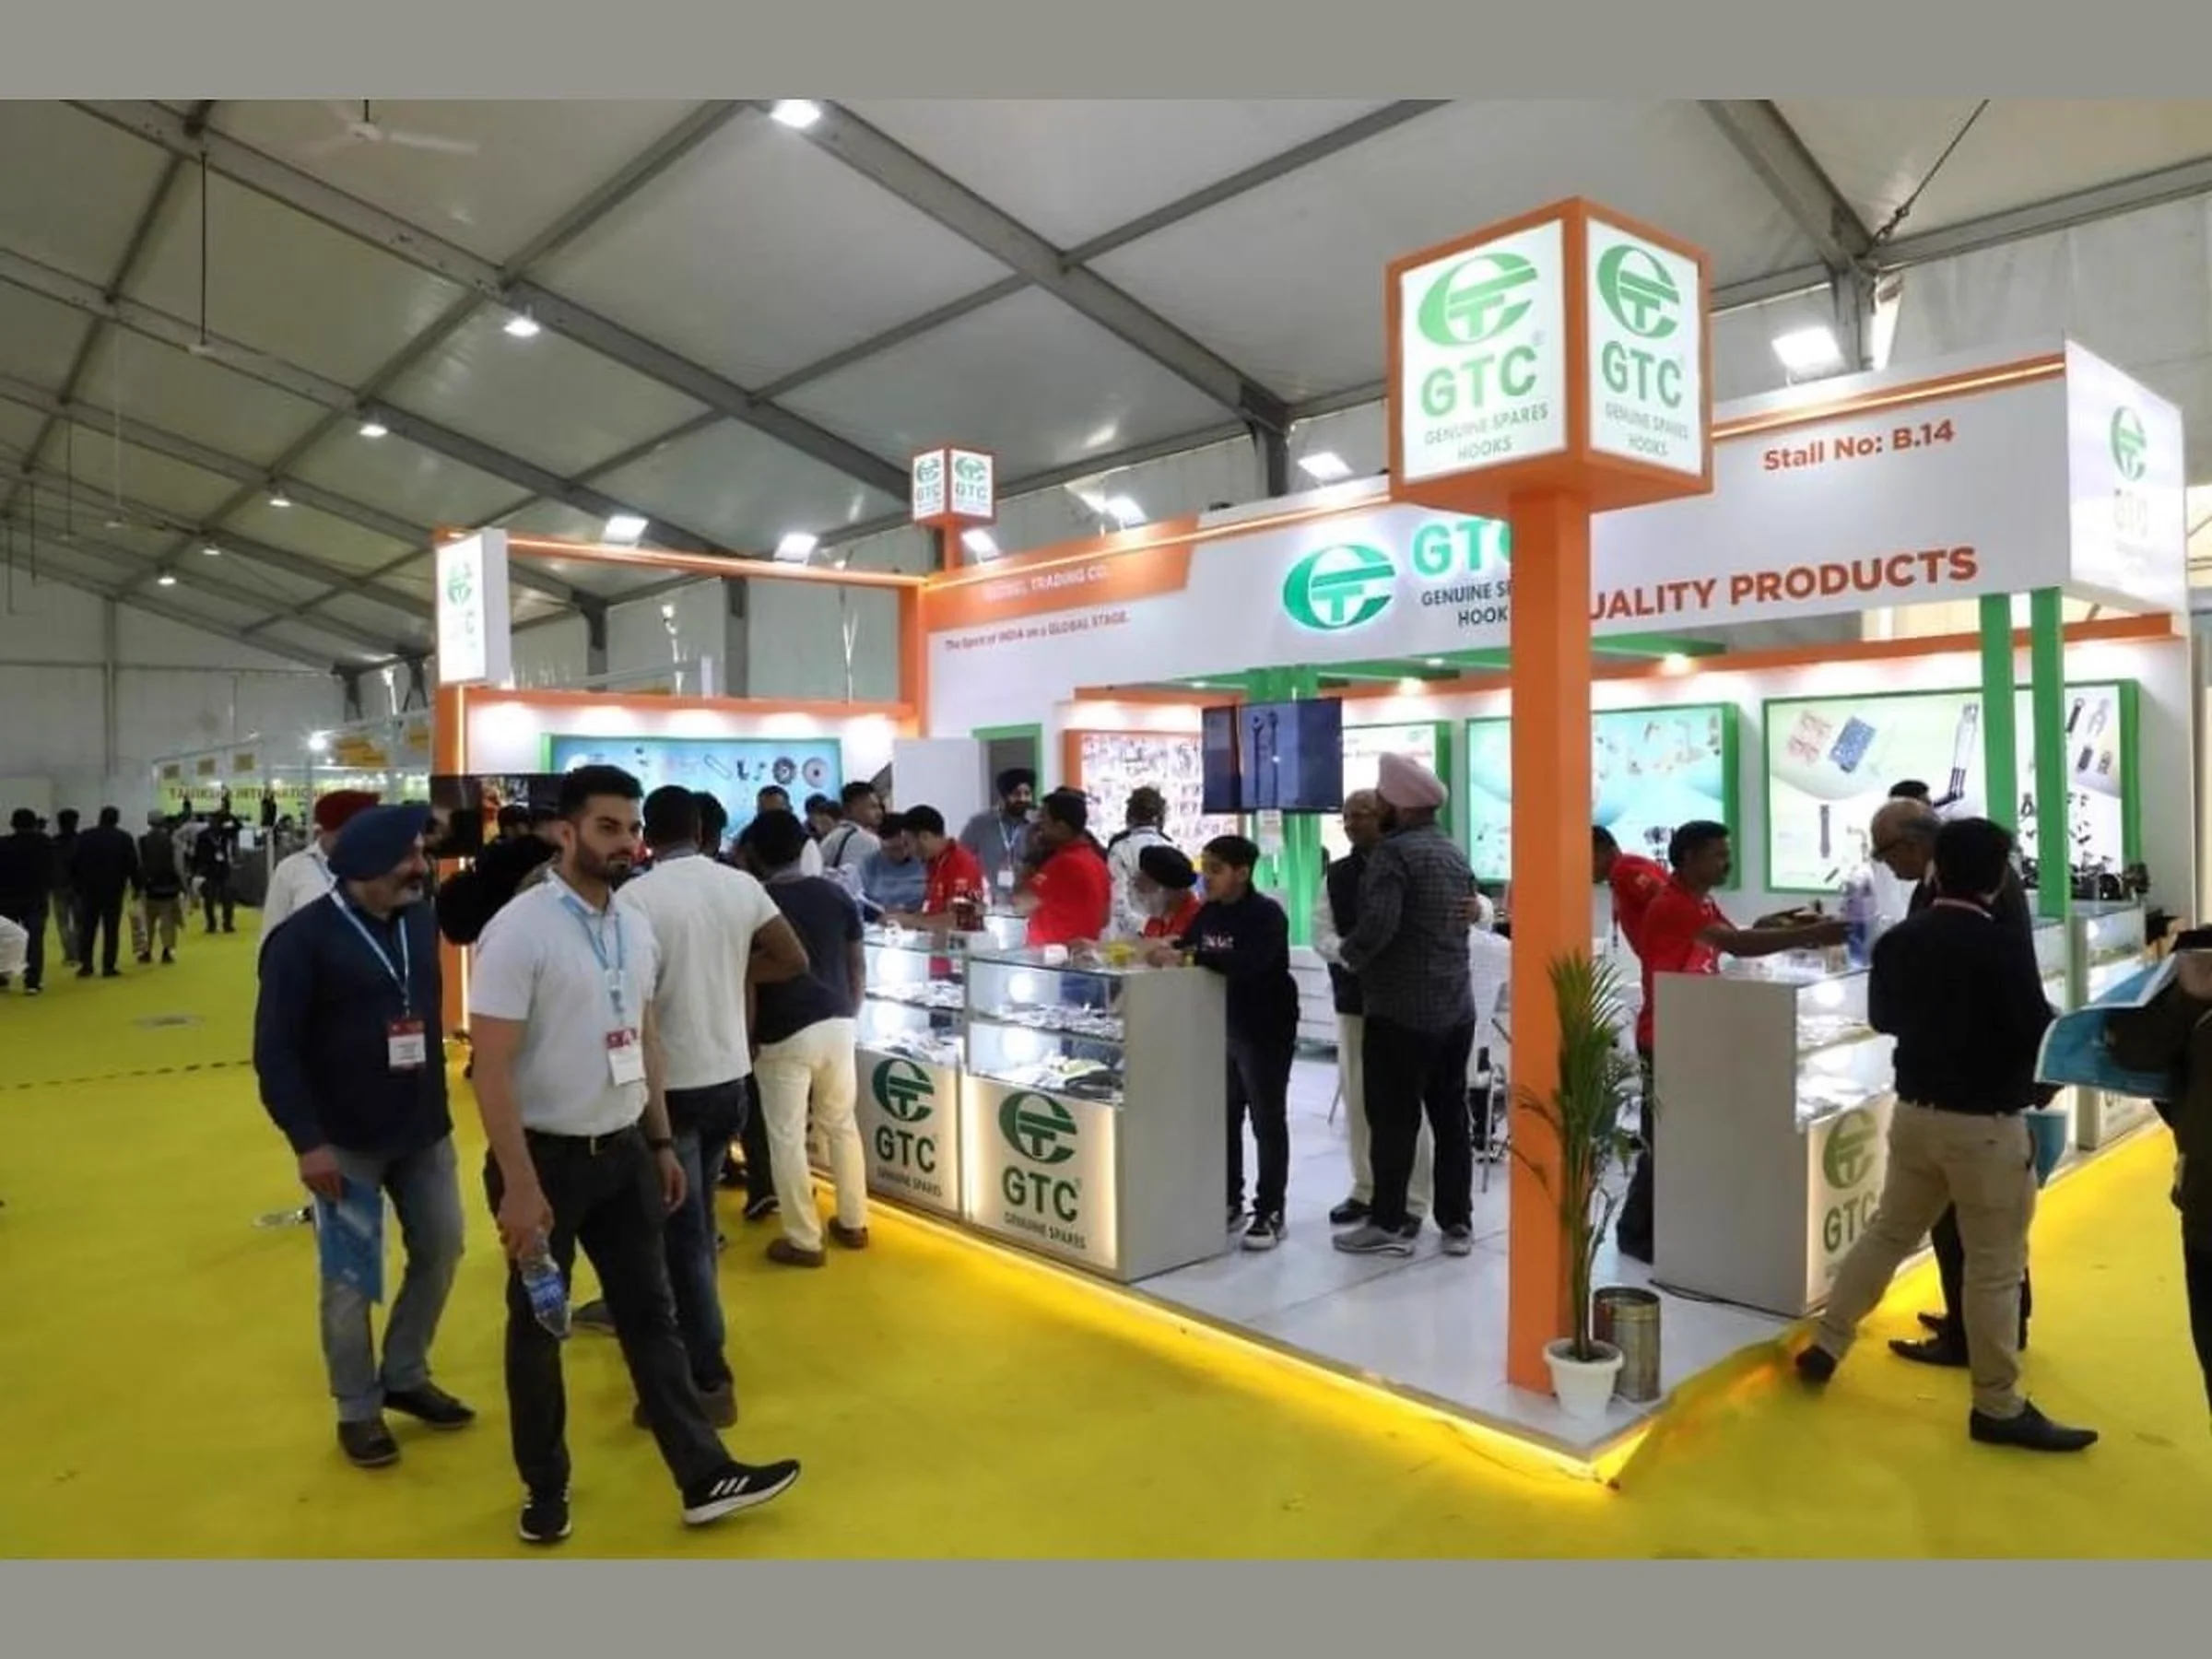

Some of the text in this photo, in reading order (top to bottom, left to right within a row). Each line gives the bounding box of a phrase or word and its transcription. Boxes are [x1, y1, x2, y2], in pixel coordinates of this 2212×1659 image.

[1420, 344, 1537, 418] GTC
[1602, 340, 1682, 409] GTC
[1425, 402, 1549, 446] GENUINE SPARES
[1628, 433, 1669, 457] HOOKS
[1763, 419, 1955, 471] Stall No: B.14
[1457, 437, 1513, 461] HOOKS
[1413, 519, 1510, 577] GT
[1421, 582, 1491, 607] GENUINE
[1590, 547, 1979, 620] UALITY PRODUCTS
[1049, 619, 1089, 635] GLOBAL
[1458, 605, 1509, 628] HOOK
[876, 1124, 935, 1173] GTC
[1002, 1164, 1078, 1223] GTC
